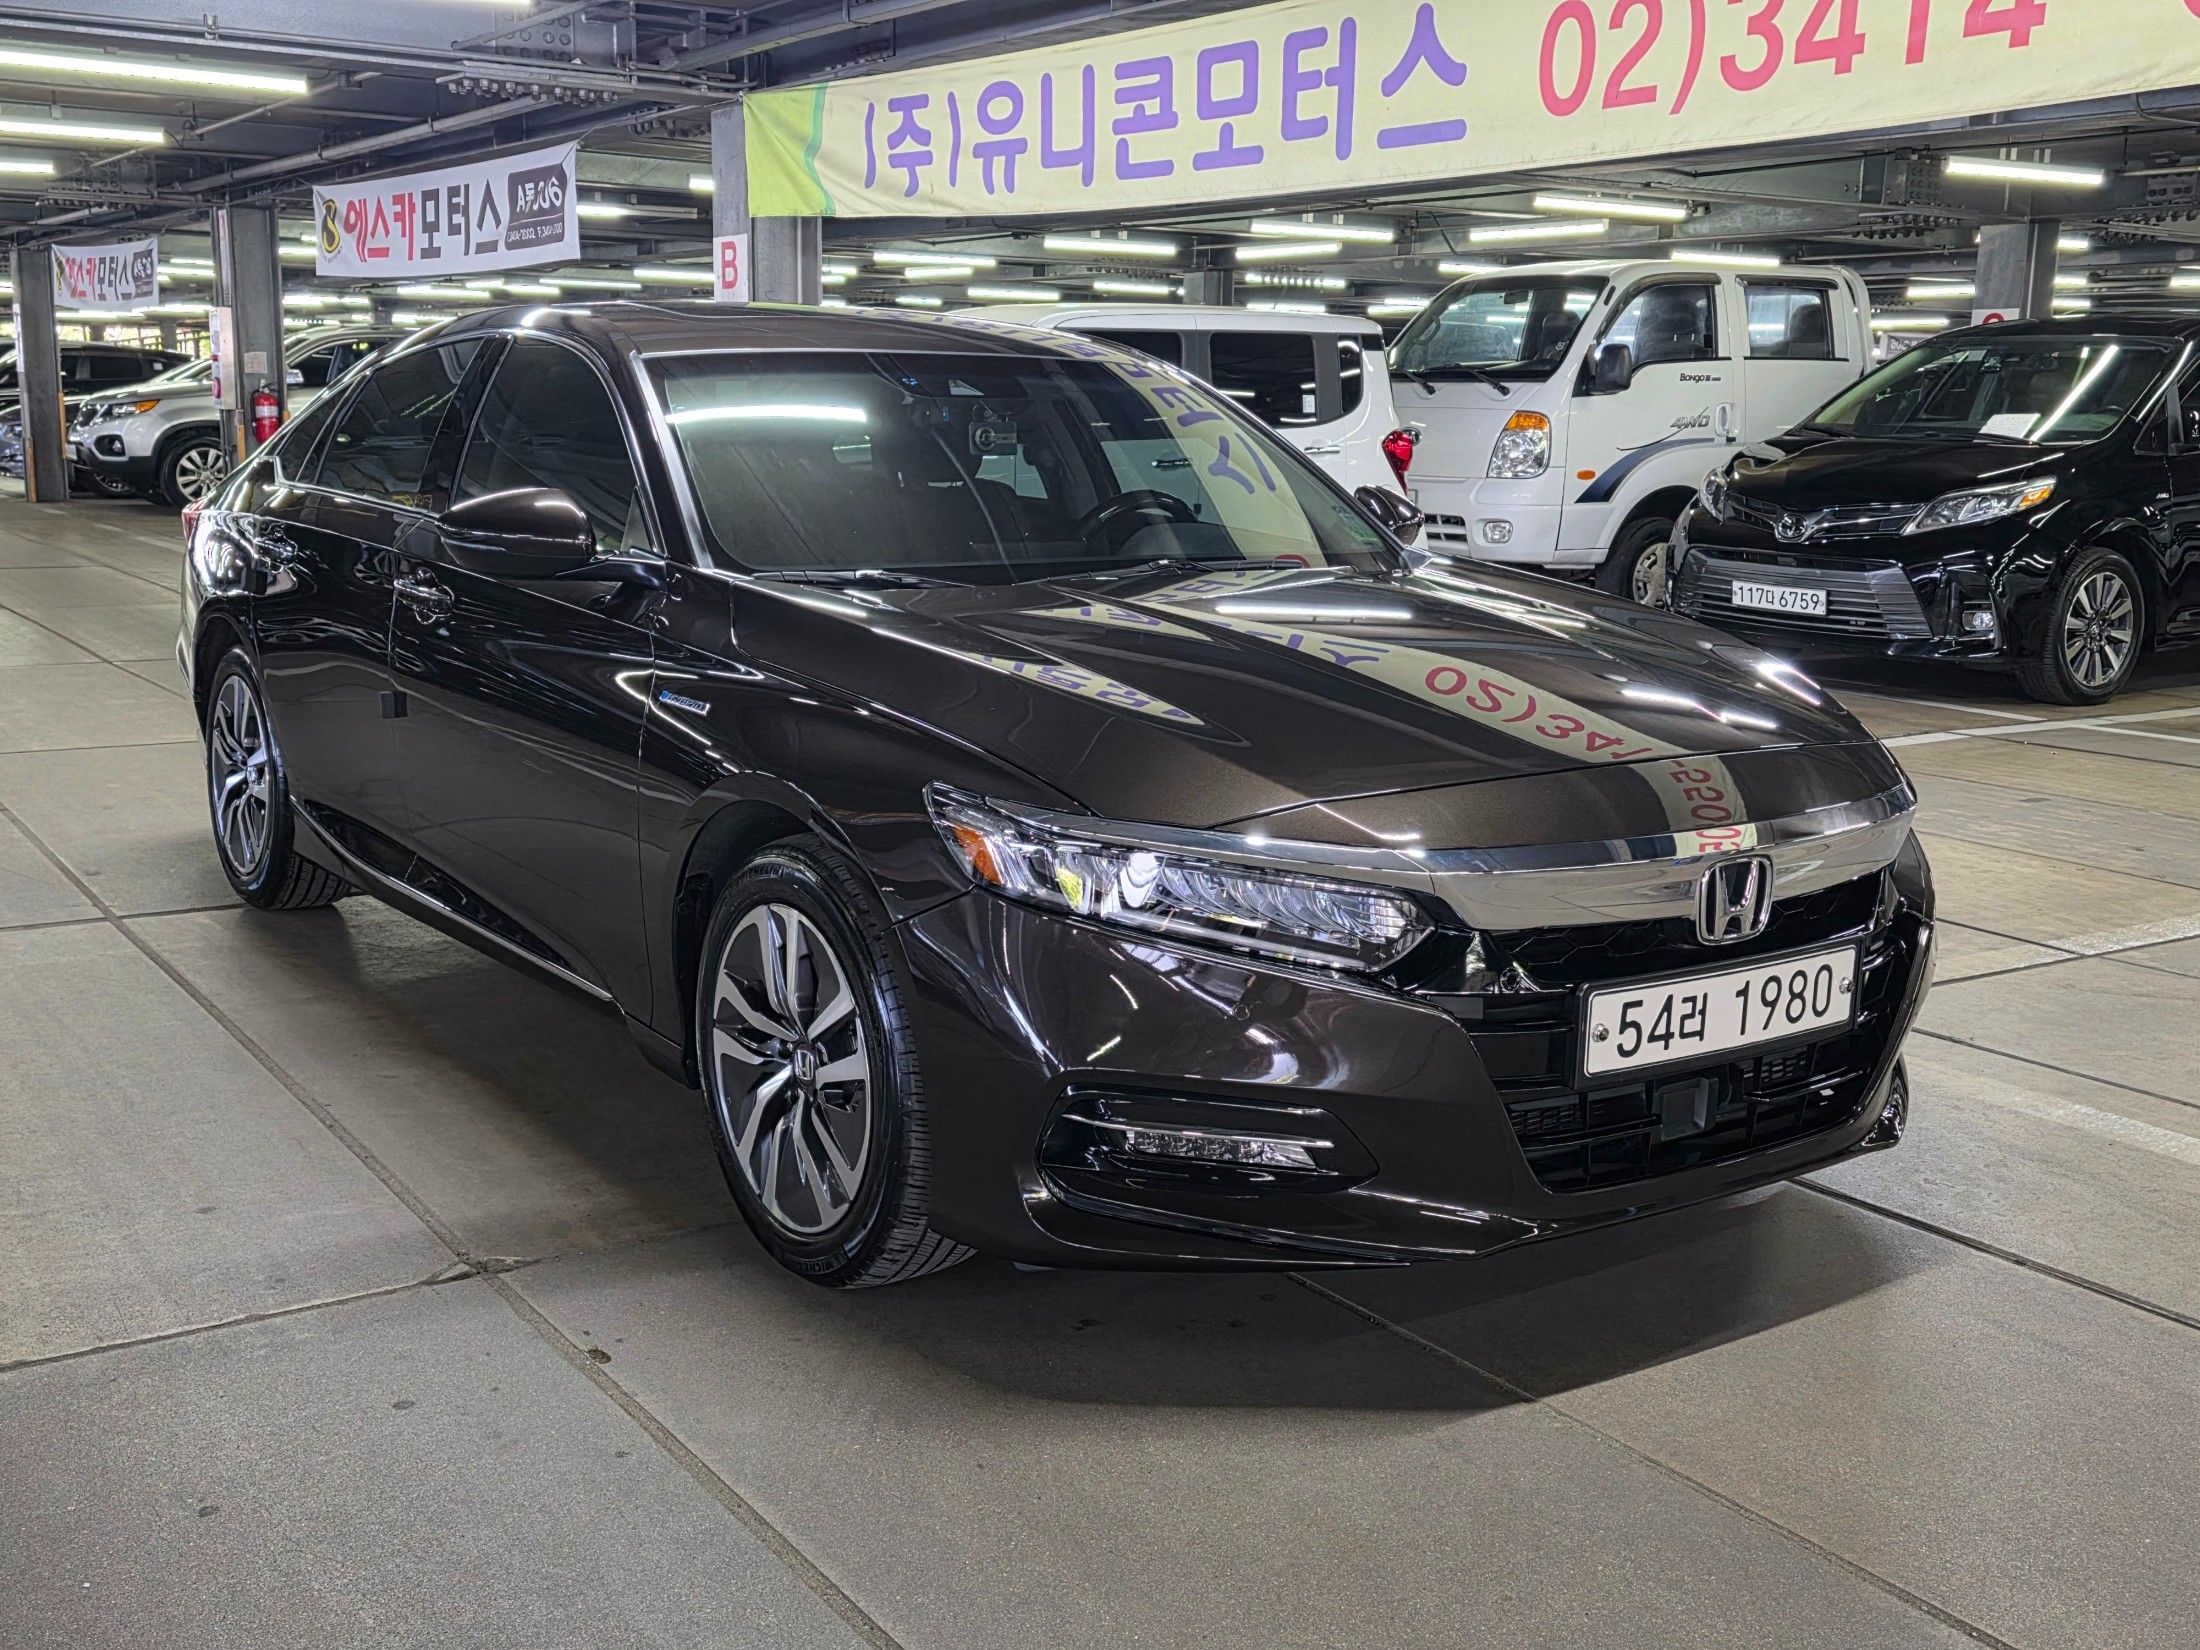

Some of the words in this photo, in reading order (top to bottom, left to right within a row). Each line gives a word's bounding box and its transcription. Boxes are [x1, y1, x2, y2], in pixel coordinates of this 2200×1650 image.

[343, 177, 502, 263] 에스카모터스
[721, 241, 738, 290] B
[1670, 415, 1710, 429] 4WD
[1738, 586, 1775, 606] 117다
[1779, 590, 1820, 611] 6759
[1616, 991, 1708, 1058] 54러
[1736, 963, 1833, 1036] 1980
